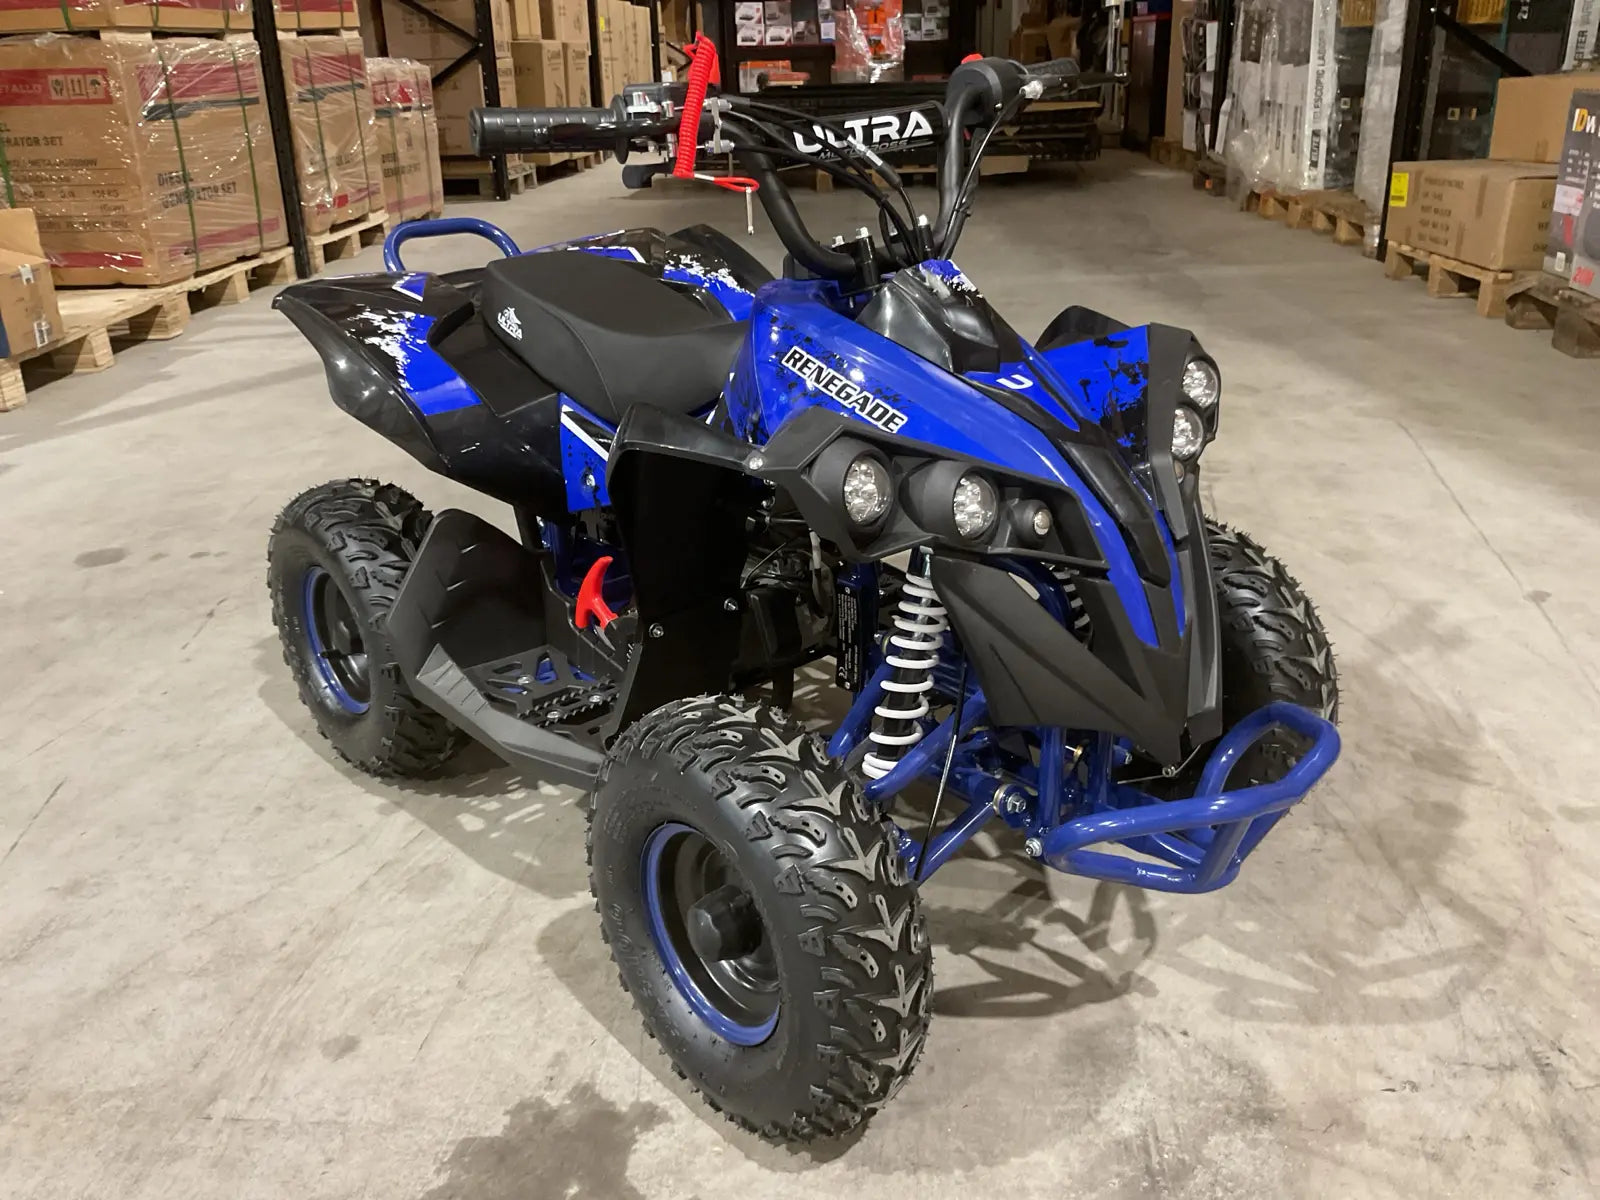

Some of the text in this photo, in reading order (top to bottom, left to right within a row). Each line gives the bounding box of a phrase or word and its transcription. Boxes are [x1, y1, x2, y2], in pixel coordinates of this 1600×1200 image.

[41, 135, 64, 146] SET
[792, 110, 934, 153] ULTRA
[220, 181, 237, 195] SET
[782, 347, 907, 433] RENEGADE
